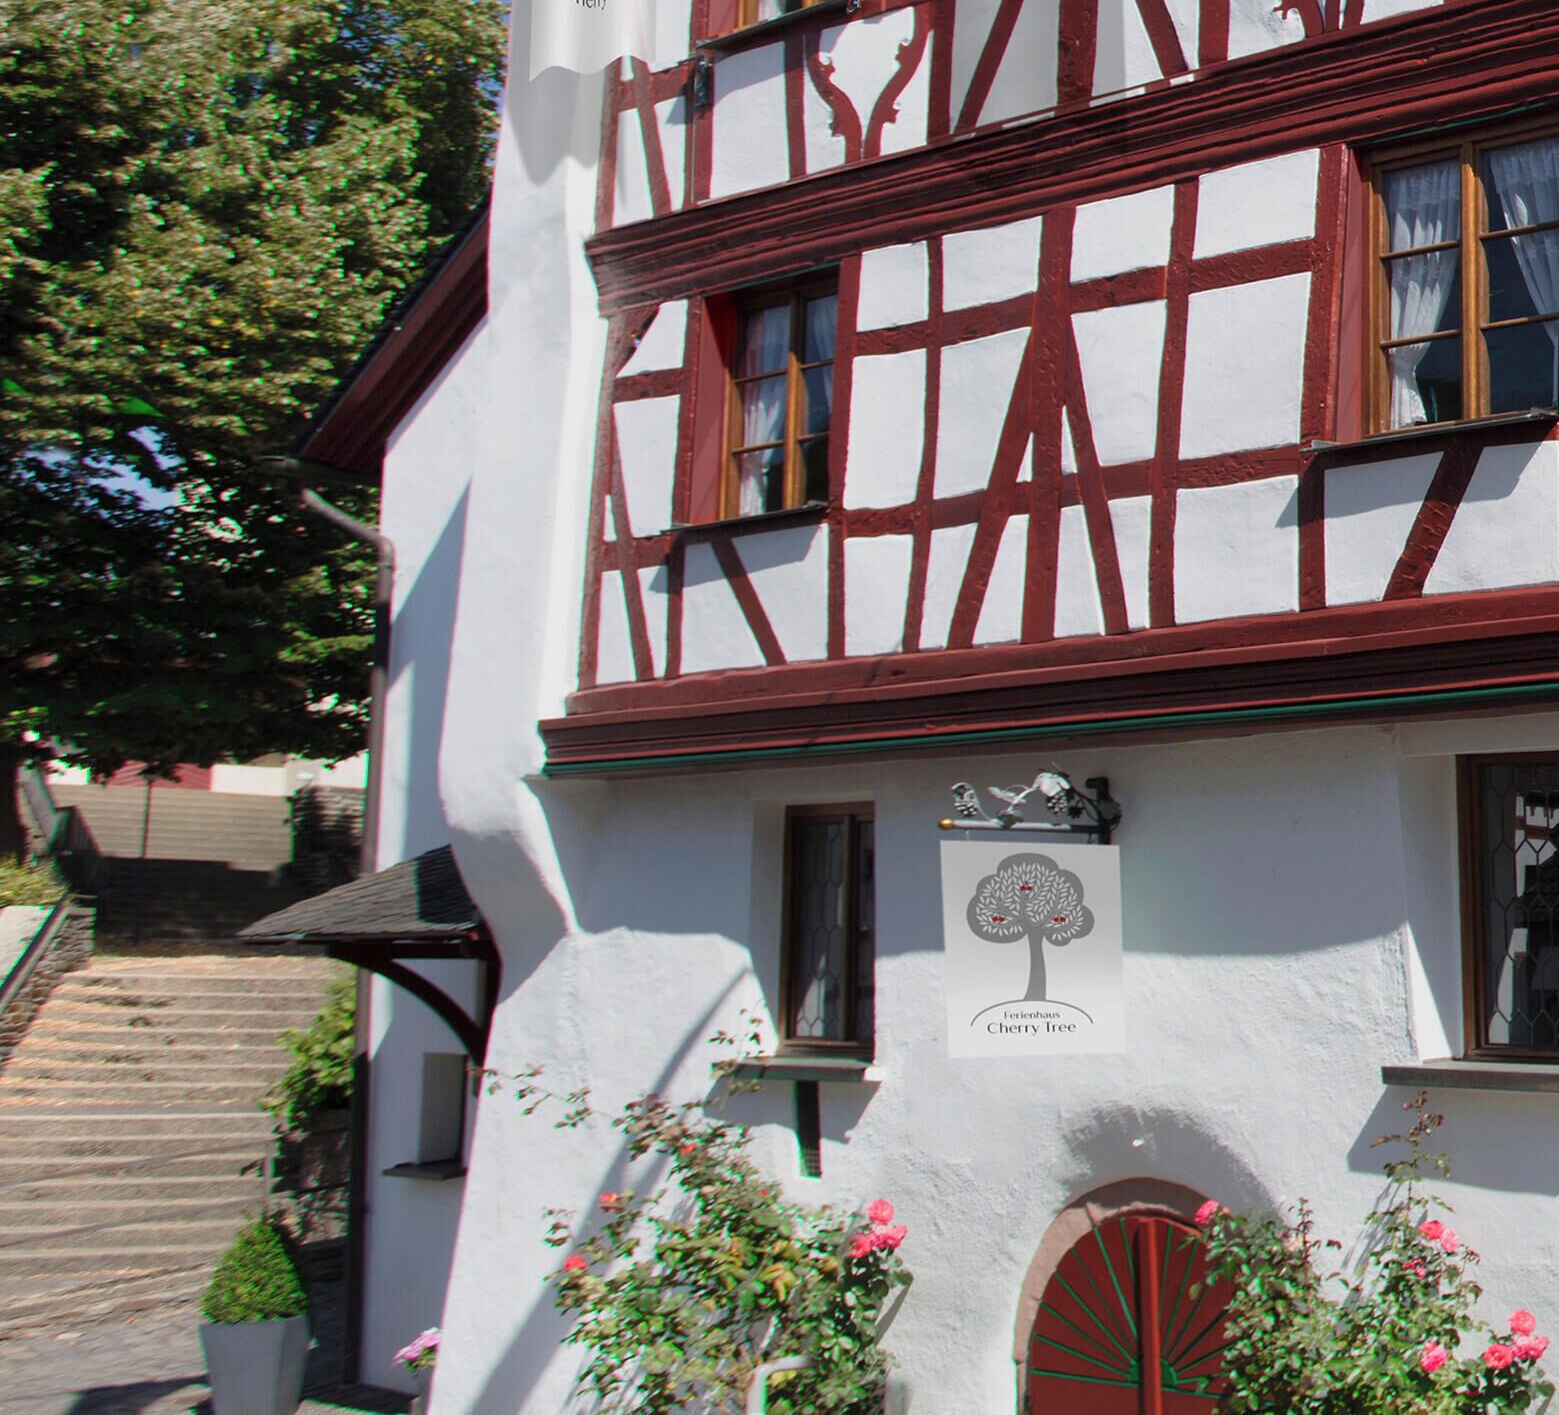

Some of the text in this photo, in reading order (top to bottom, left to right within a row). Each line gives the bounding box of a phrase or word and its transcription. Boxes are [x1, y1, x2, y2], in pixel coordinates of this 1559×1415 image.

[1003, 1010, 1061, 1020] Ferienhaus
[986, 1021, 1077, 1037] Cherry Tree
